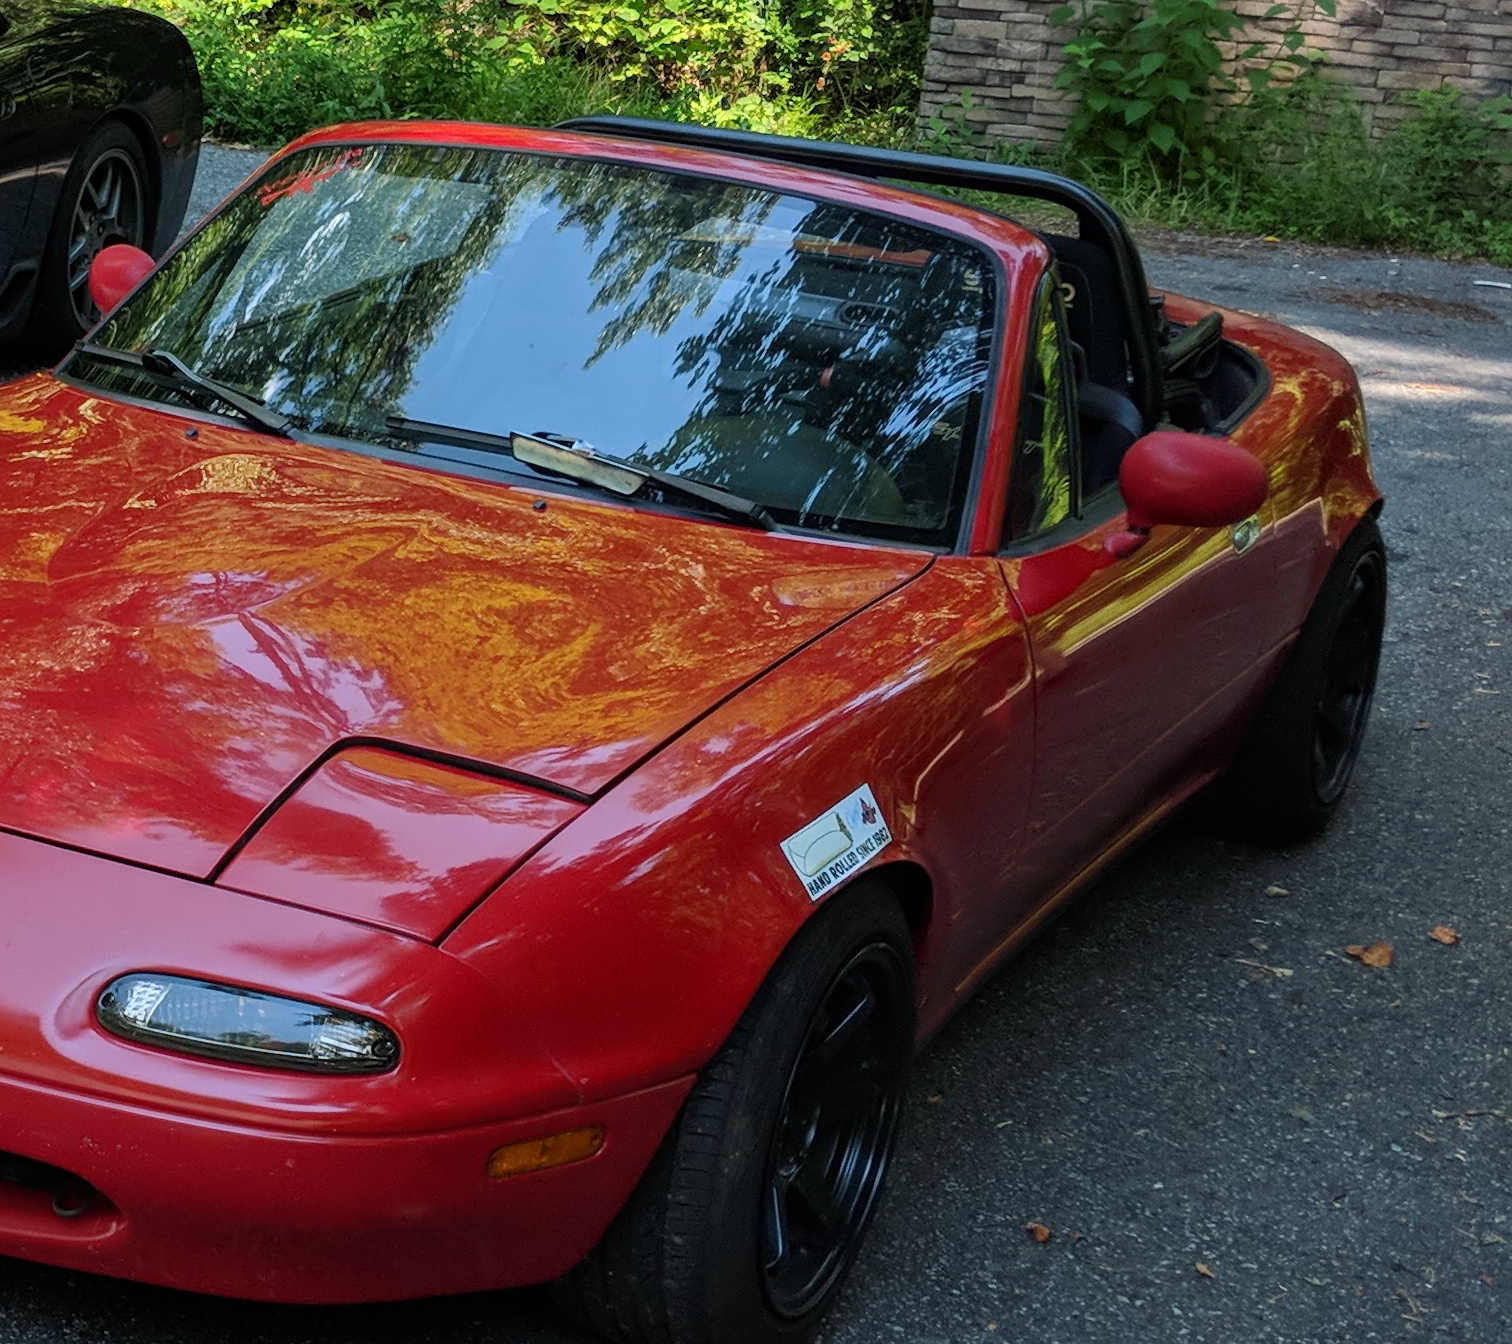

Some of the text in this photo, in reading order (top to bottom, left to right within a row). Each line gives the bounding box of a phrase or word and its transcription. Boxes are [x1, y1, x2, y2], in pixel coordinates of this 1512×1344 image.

[806, 872, 832, 897] HAND
[829, 852, 860, 880] ROLLED
[856, 838, 876, 859] SINCE
